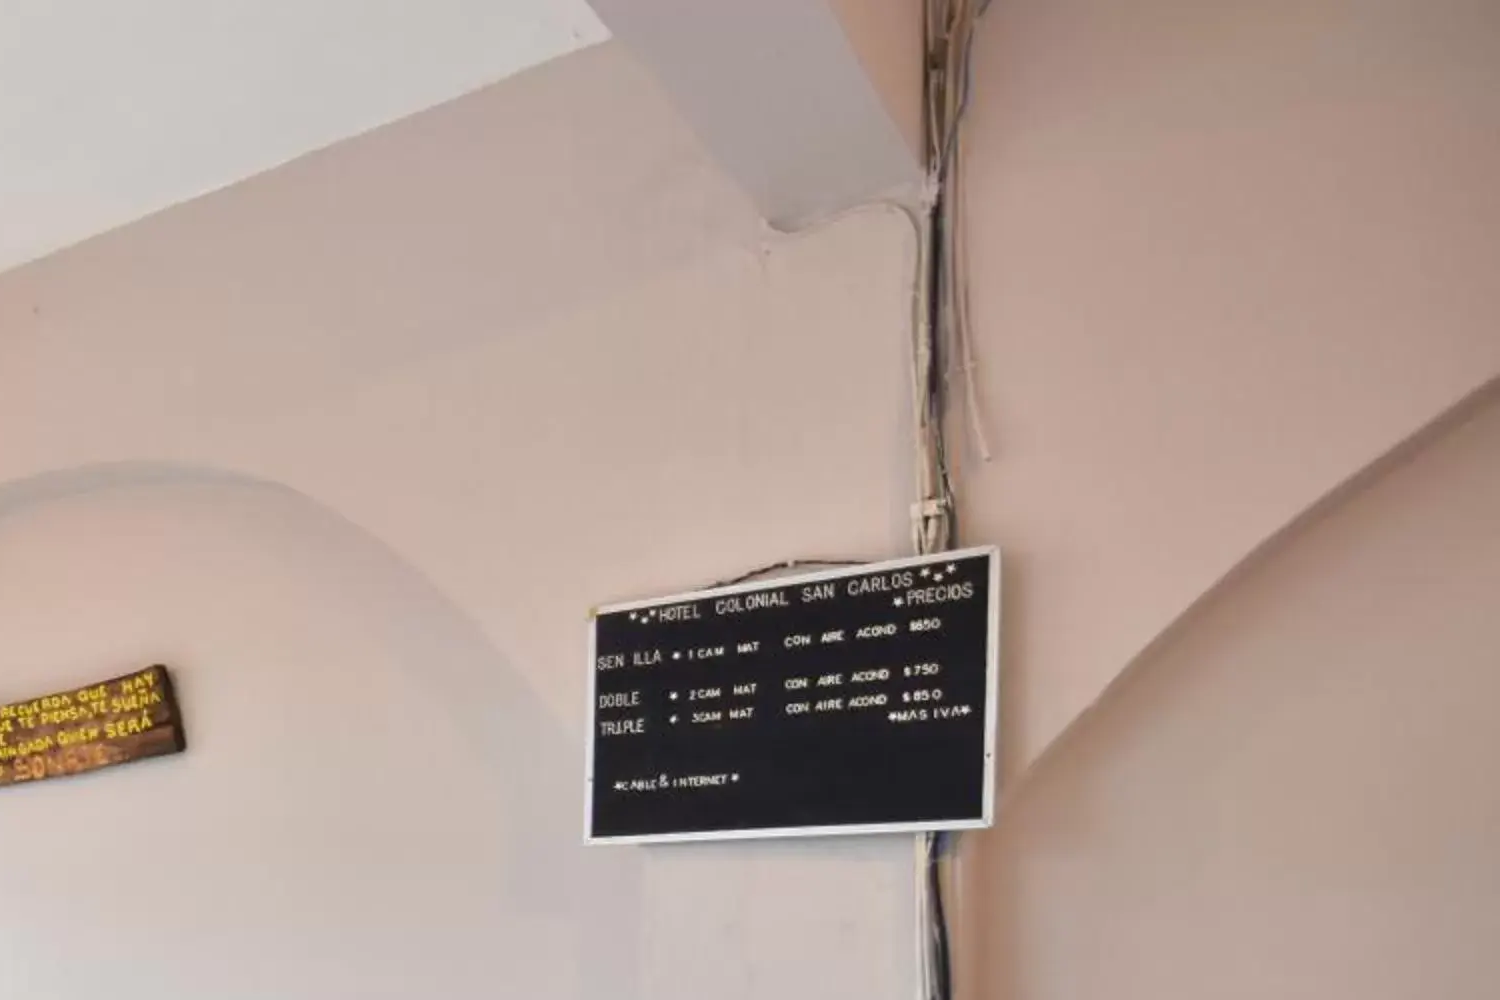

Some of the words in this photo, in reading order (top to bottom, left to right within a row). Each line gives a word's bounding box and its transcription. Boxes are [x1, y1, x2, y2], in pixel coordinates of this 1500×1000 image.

[659, 603, 701, 623] HOTEL
[801, 584, 835, 604] SAN
[847, 572, 914, 597] CARLOS
[907, 583, 974, 607] PRECIOS
[737, 641, 761, 656] MAT
[784, 633, 812, 648] CON
[856, 623, 897, 639] ACOND
[77, 685, 108, 703] QUE
[121, 671, 154, 694] HAY
[599, 691, 641, 709] DOBLE
[733, 683, 757, 696] MAT
[784, 676, 808, 690] CON
[817, 672, 844, 687] AIRE
[850, 668, 889, 683] ACOND
[18, 715, 35, 729] TE
[600, 719, 645, 735] TRIPLE
[729, 707, 754, 721] MAT
[785, 702, 810, 716] CON
[815, 698, 842, 711] AIRE
[847, 693, 888, 707] ACOND
